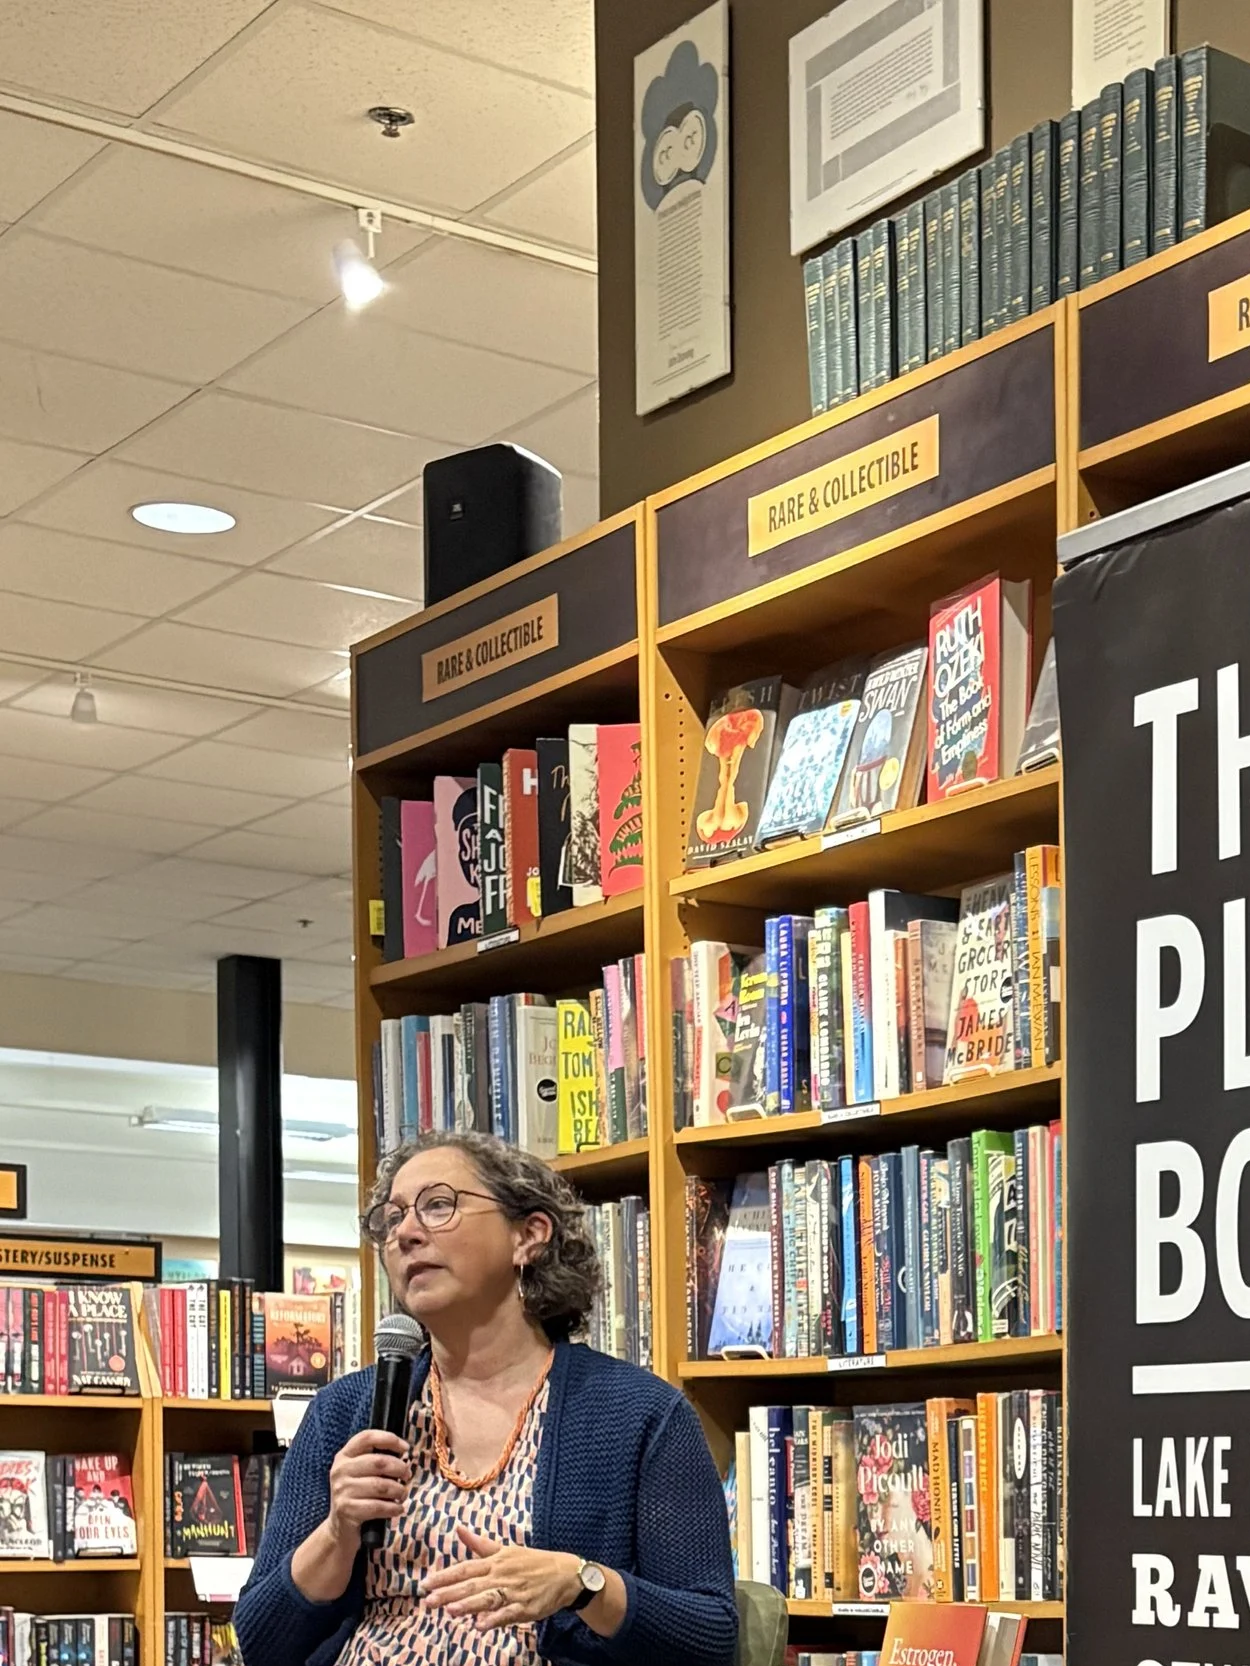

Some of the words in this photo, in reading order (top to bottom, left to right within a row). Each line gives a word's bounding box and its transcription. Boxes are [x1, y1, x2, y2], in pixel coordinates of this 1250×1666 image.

[768, 496, 804, 533] RARE
[807, 489, 821, 516] &
[822, 441, 920, 511] COLLECTIBLE
[936, 597, 983, 663] RUTH
[436, 657, 463, 685] RARE
[465, 648, 474, 672] &
[475, 615, 544, 667] COLLECTIBLE
[934, 631, 986, 699] OZEKI
[859, 676, 916, 724] SWAN
[940, 695, 957, 718] The
[957, 674, 985, 703] Book
[971, 688, 992, 718] and
[1030, 951, 1041, 980] IAN
[956, 1008, 1004, 1041] JAMES
[945, 1032, 1013, 1069] McBRIDE
[77, 1289, 123, 1305] KNOW
[81, 1304, 128, 1318] PLACE
[768, 1427, 781, 1452] bel
[872, 1433, 909, 1461] Jodi
[104, 1456, 118, 1470] UP
[932, 1441, 940, 1472] MAD
[858, 1467, 925, 1495] Picoult
[1132, 1436, 1232, 1518] LAKE
[932, 1476, 942, 1523] HONEY
[182, 1525, 234, 1541] MANHUNT
[890, 1518, 916, 1533] ANY
[873, 1538, 915, 1554] OTHER
[876, 1560, 914, 1576] NAME
